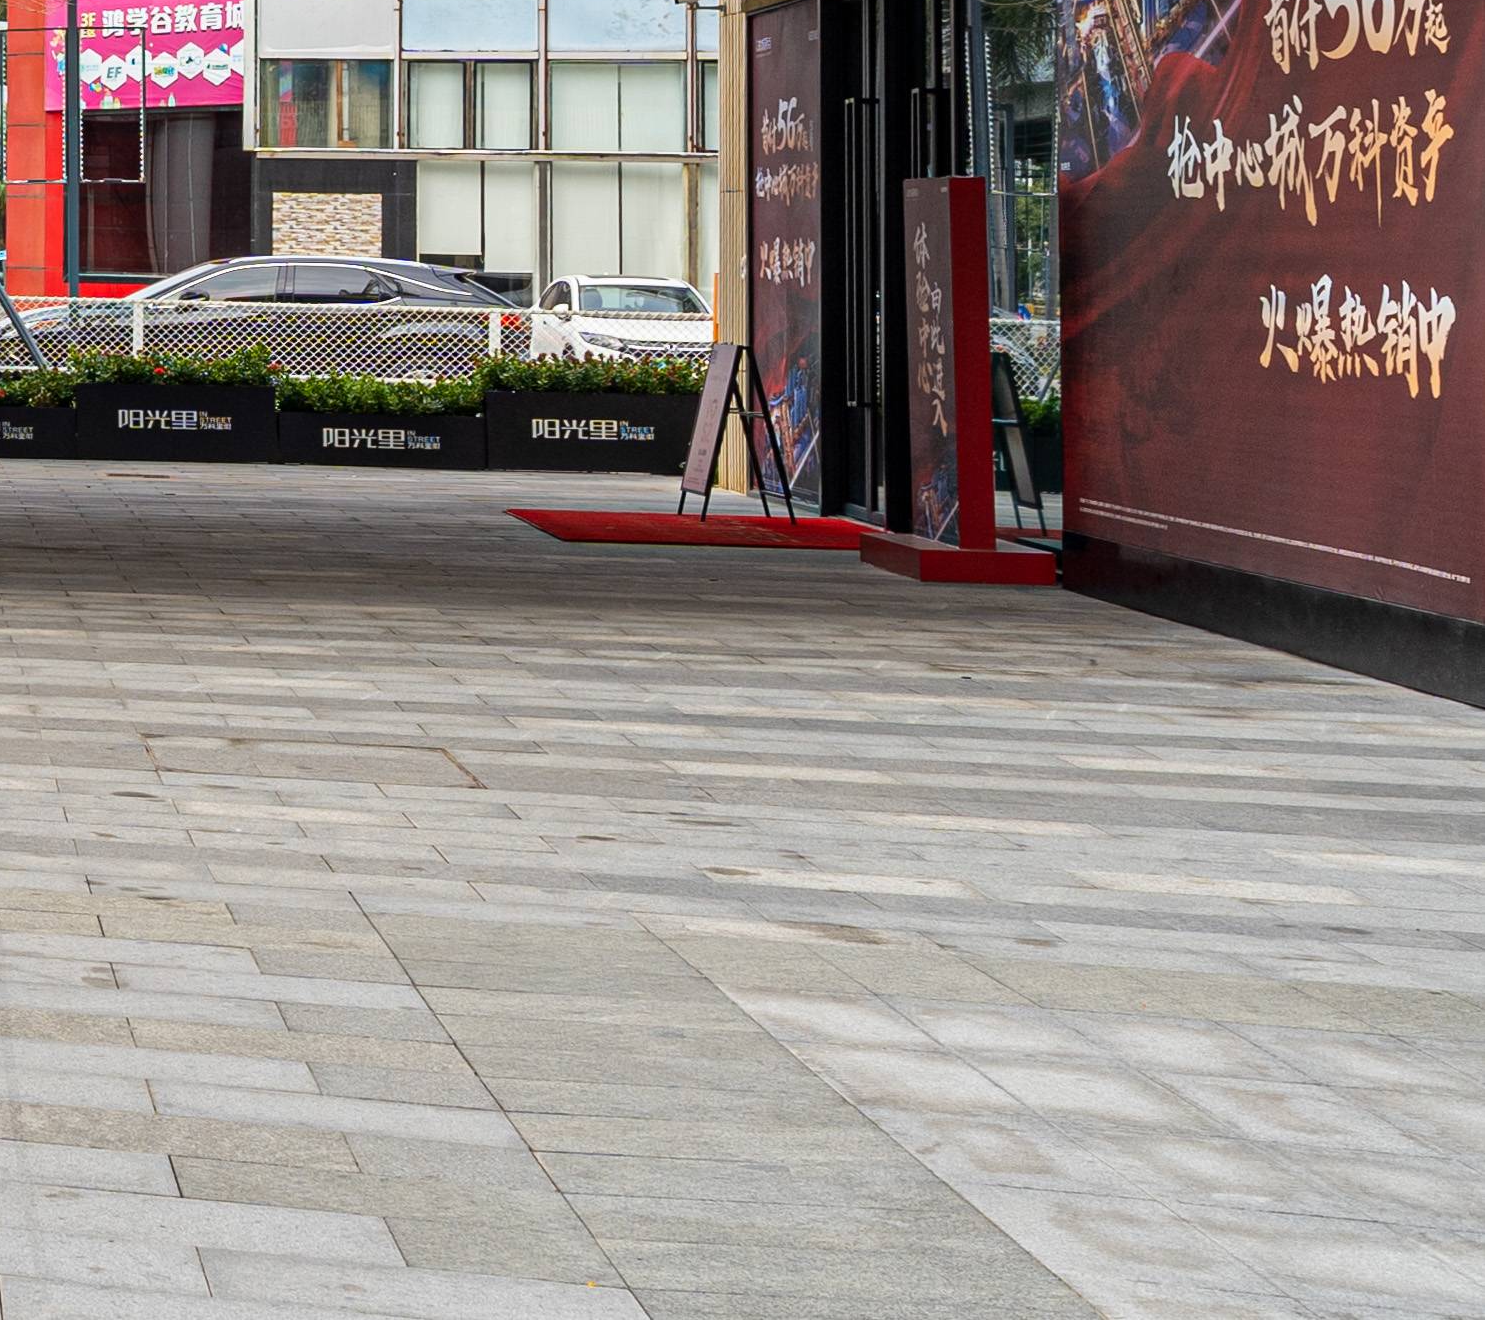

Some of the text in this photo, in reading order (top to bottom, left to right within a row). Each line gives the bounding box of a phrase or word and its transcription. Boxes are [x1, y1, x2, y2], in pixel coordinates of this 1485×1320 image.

[1167, 89, 1454, 230] 抢中心城万科资产
[1259, 274, 1457, 399] 火爆热销中
[117, 409, 198, 430] 阳光里
[531, 418, 618, 441] 阳光里
[322, 427, 406, 450] 阳光里
